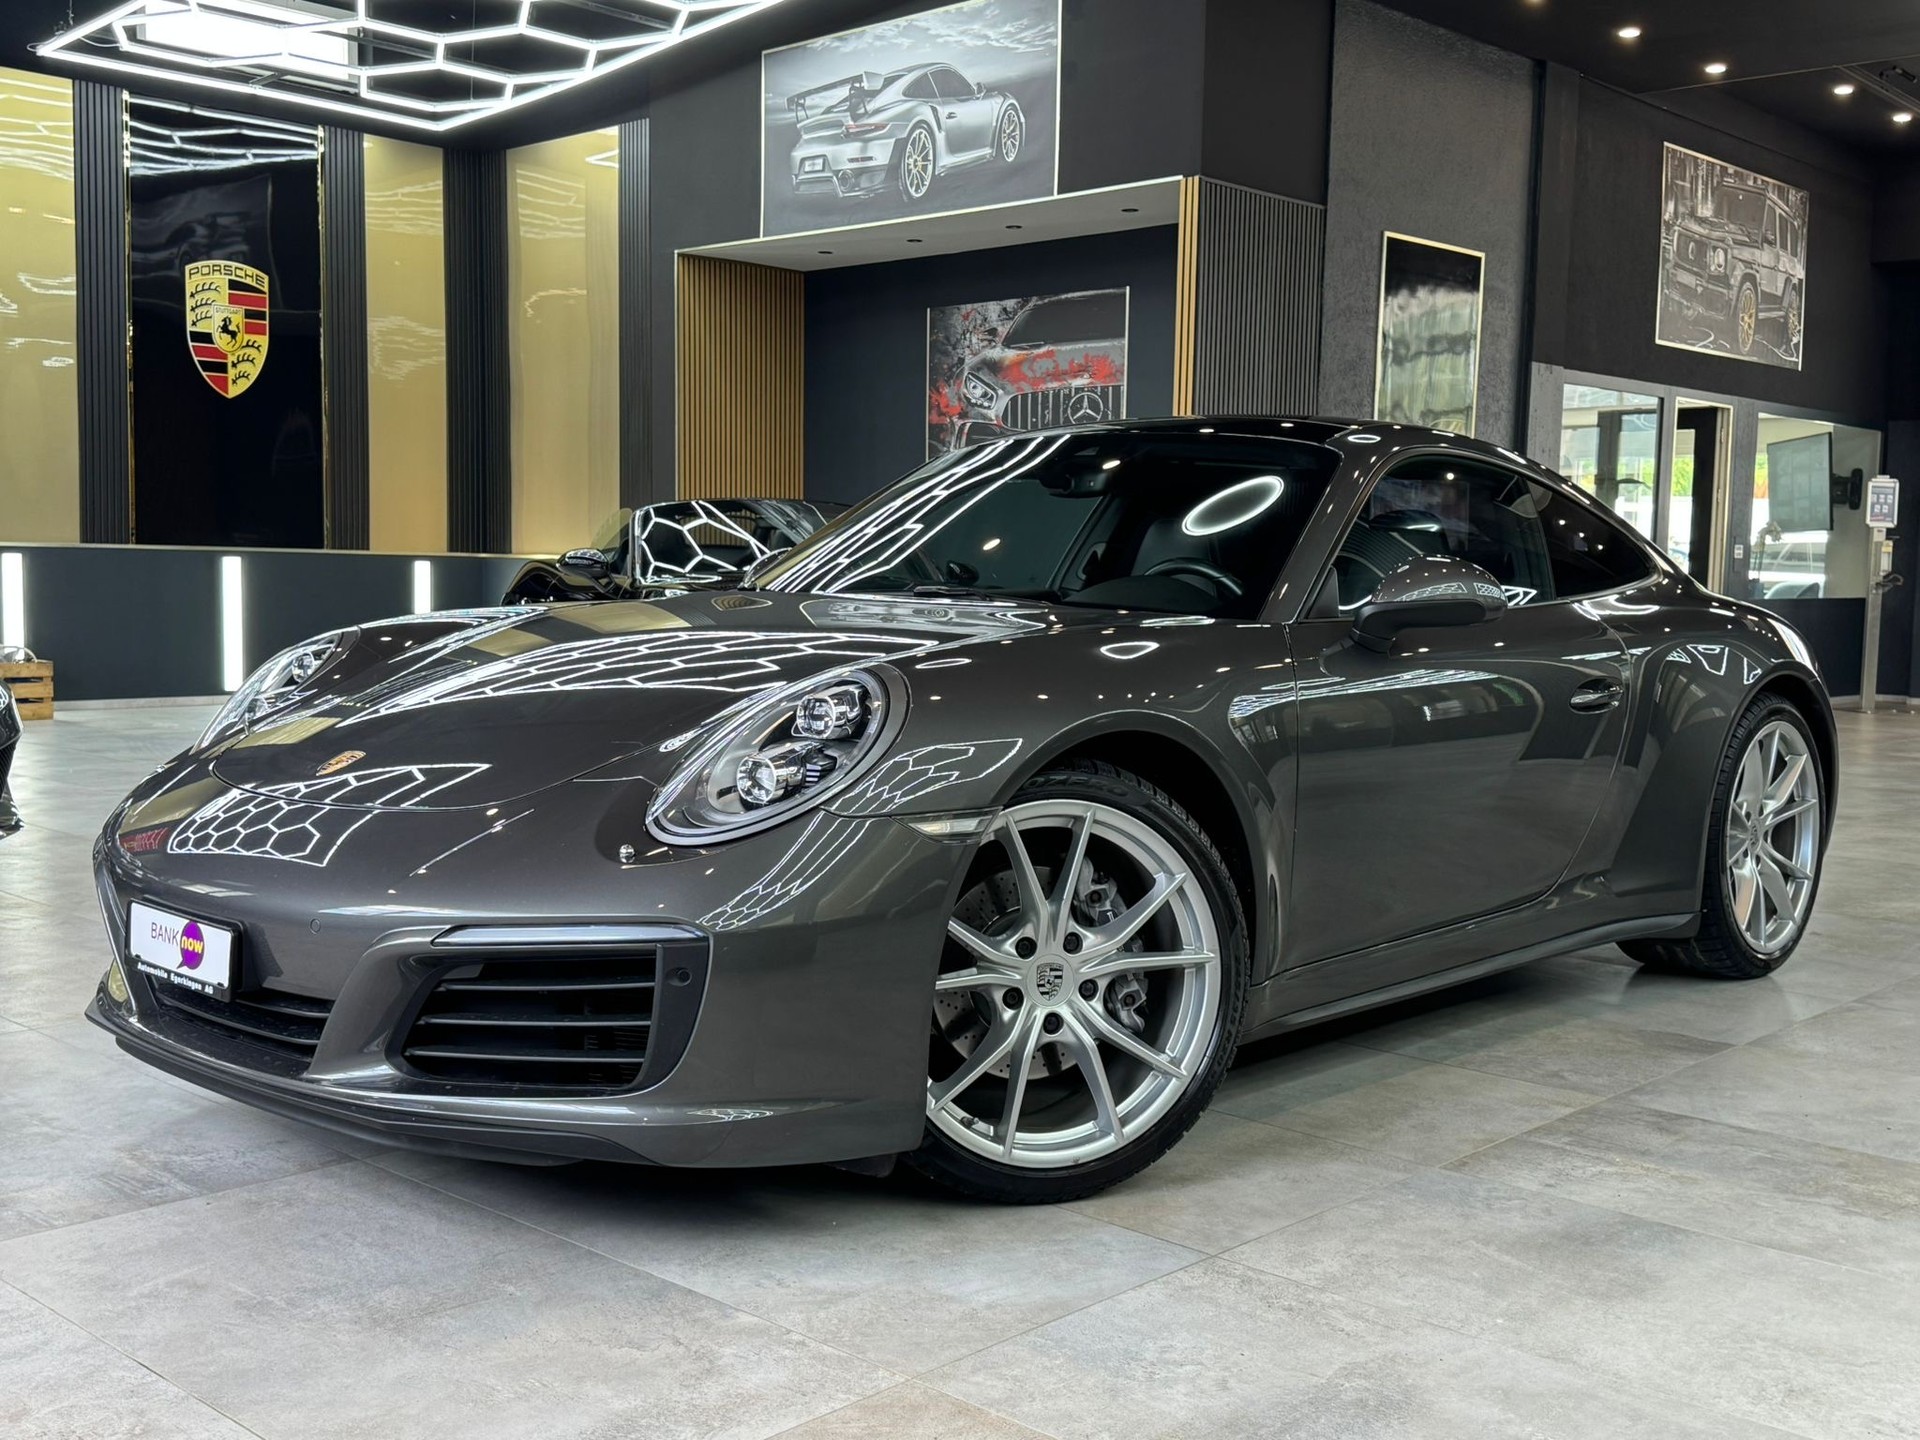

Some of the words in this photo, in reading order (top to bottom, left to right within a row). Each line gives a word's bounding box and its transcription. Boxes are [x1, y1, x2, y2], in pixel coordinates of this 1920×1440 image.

[188, 263, 266, 289] PORSCHE
[150, 921, 180, 947] BANK
[181, 935, 204, 954] now
[137, 961, 168, 979] Automobile
[204, 984, 214, 995] AG
